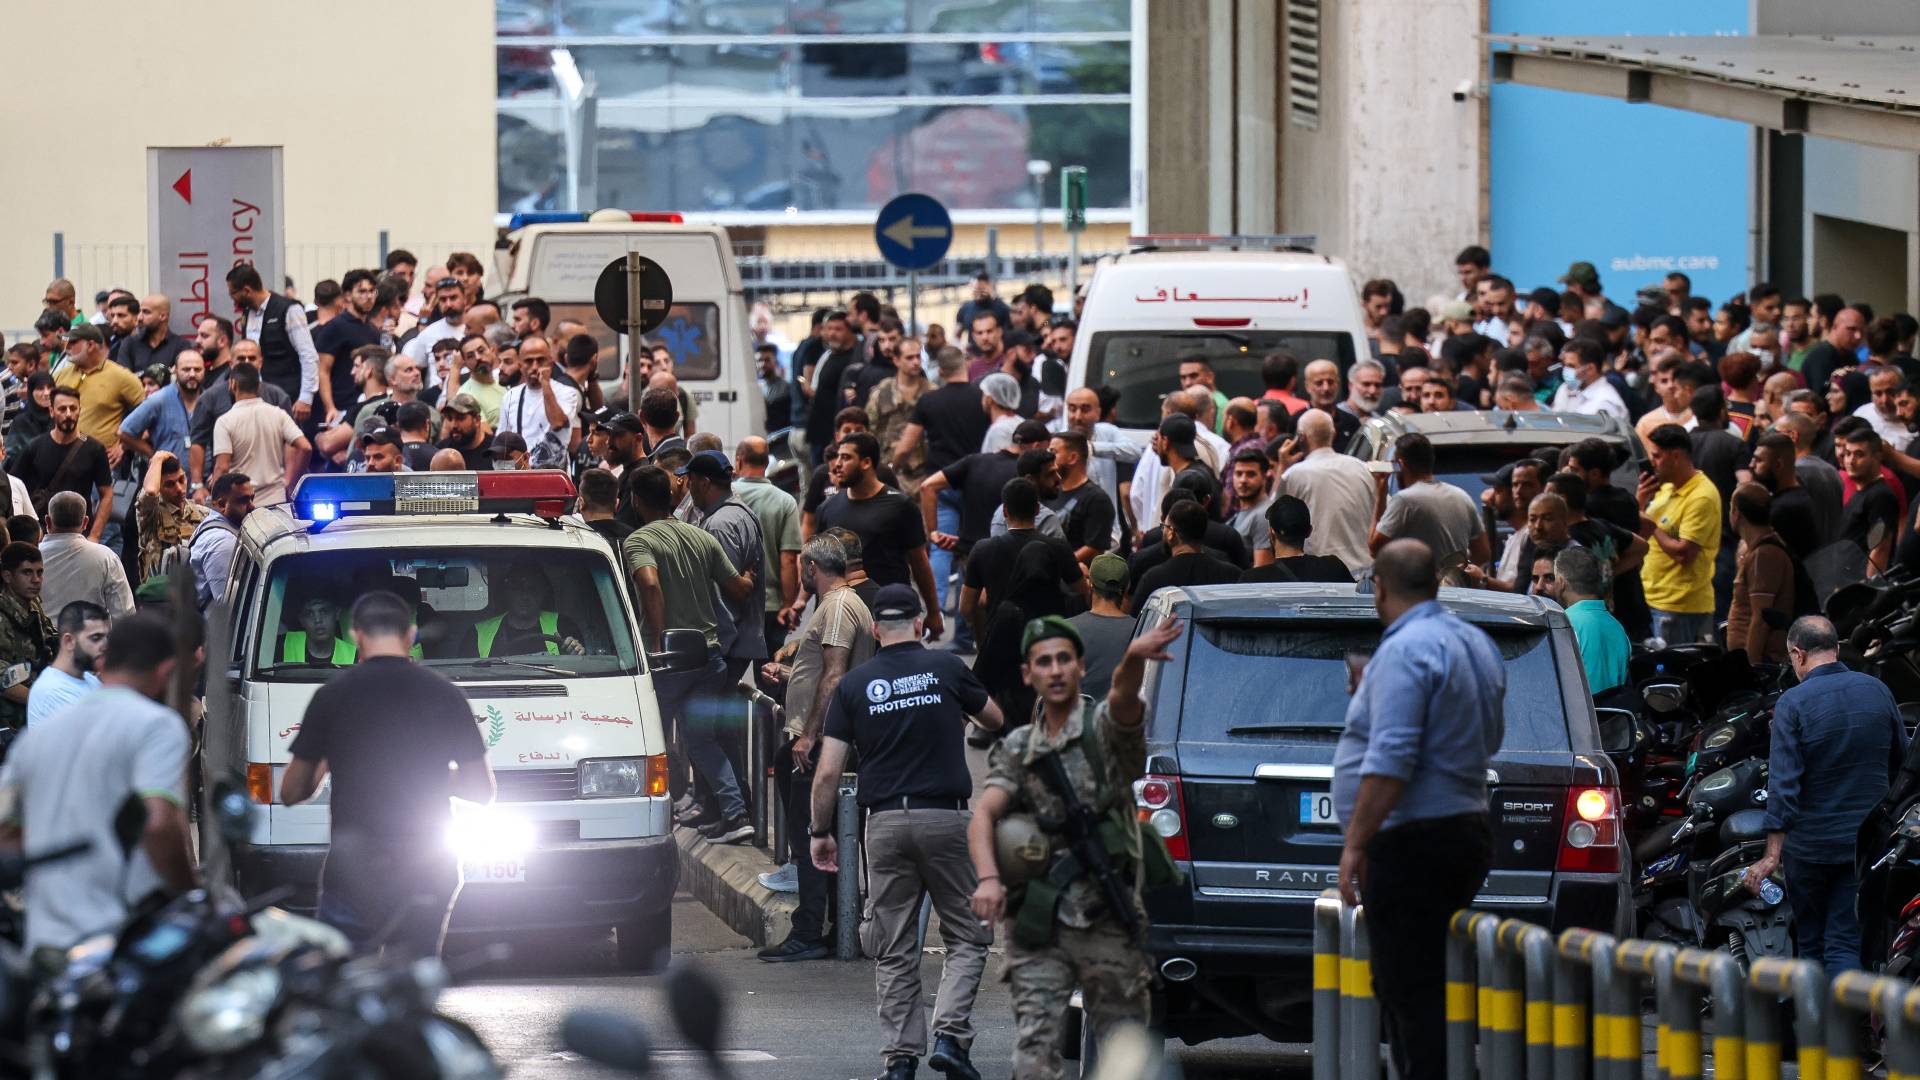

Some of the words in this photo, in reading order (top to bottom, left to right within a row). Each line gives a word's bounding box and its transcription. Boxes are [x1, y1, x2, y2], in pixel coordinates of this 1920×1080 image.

[1135, 286, 1309, 309] إسعاف
[893, 672, 933, 685] AMERICAN
[893, 678, 939, 691] UNIVERSITY
[900, 684, 928, 695] BEIRUT
[869, 694, 942, 716] PROTECTION
[514, 710, 573, 725] الرسالة
[580, 709, 634, 729] جمعية
[1503, 802, 1554, 812] SPORT
